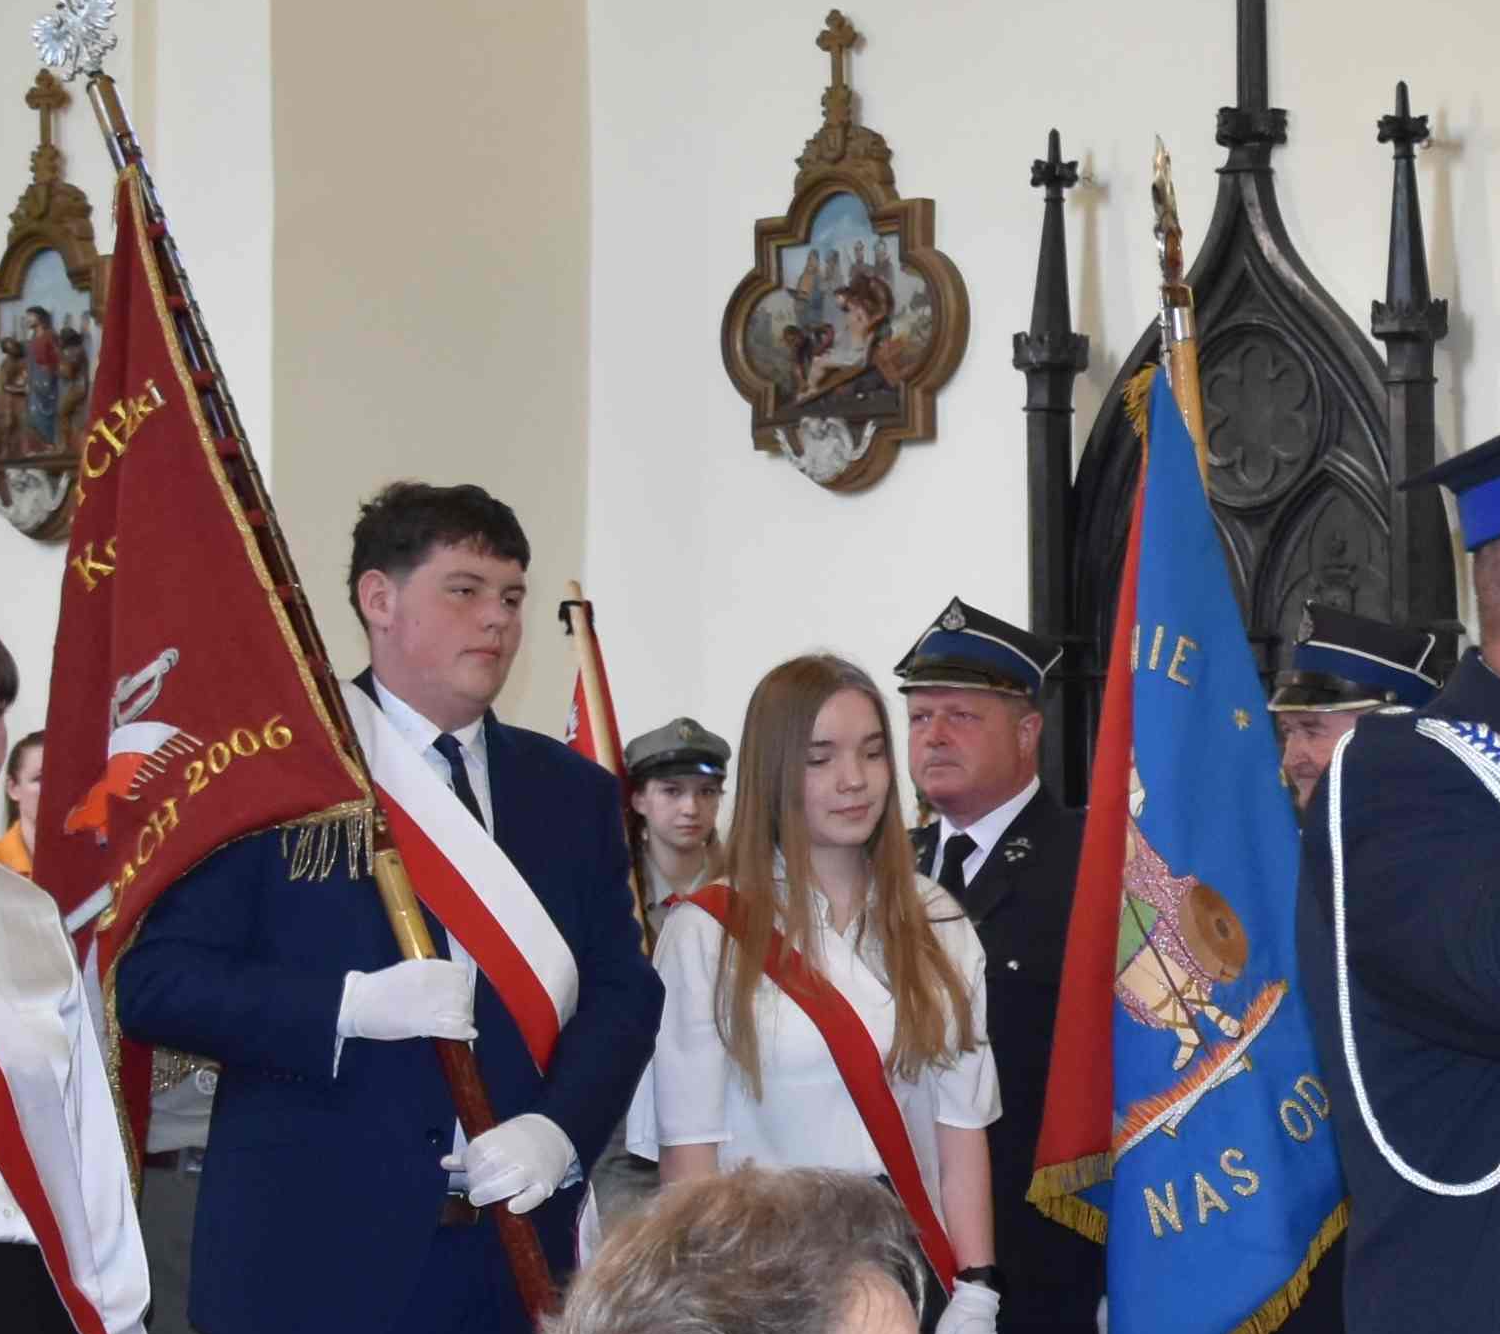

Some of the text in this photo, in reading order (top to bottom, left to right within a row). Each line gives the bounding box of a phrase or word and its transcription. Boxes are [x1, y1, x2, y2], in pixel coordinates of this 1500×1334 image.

[1131, 624, 1198, 688] IE
[184, 715, 293, 797] 2006
[1144, 1075, 1330, 1238] NAS OD
